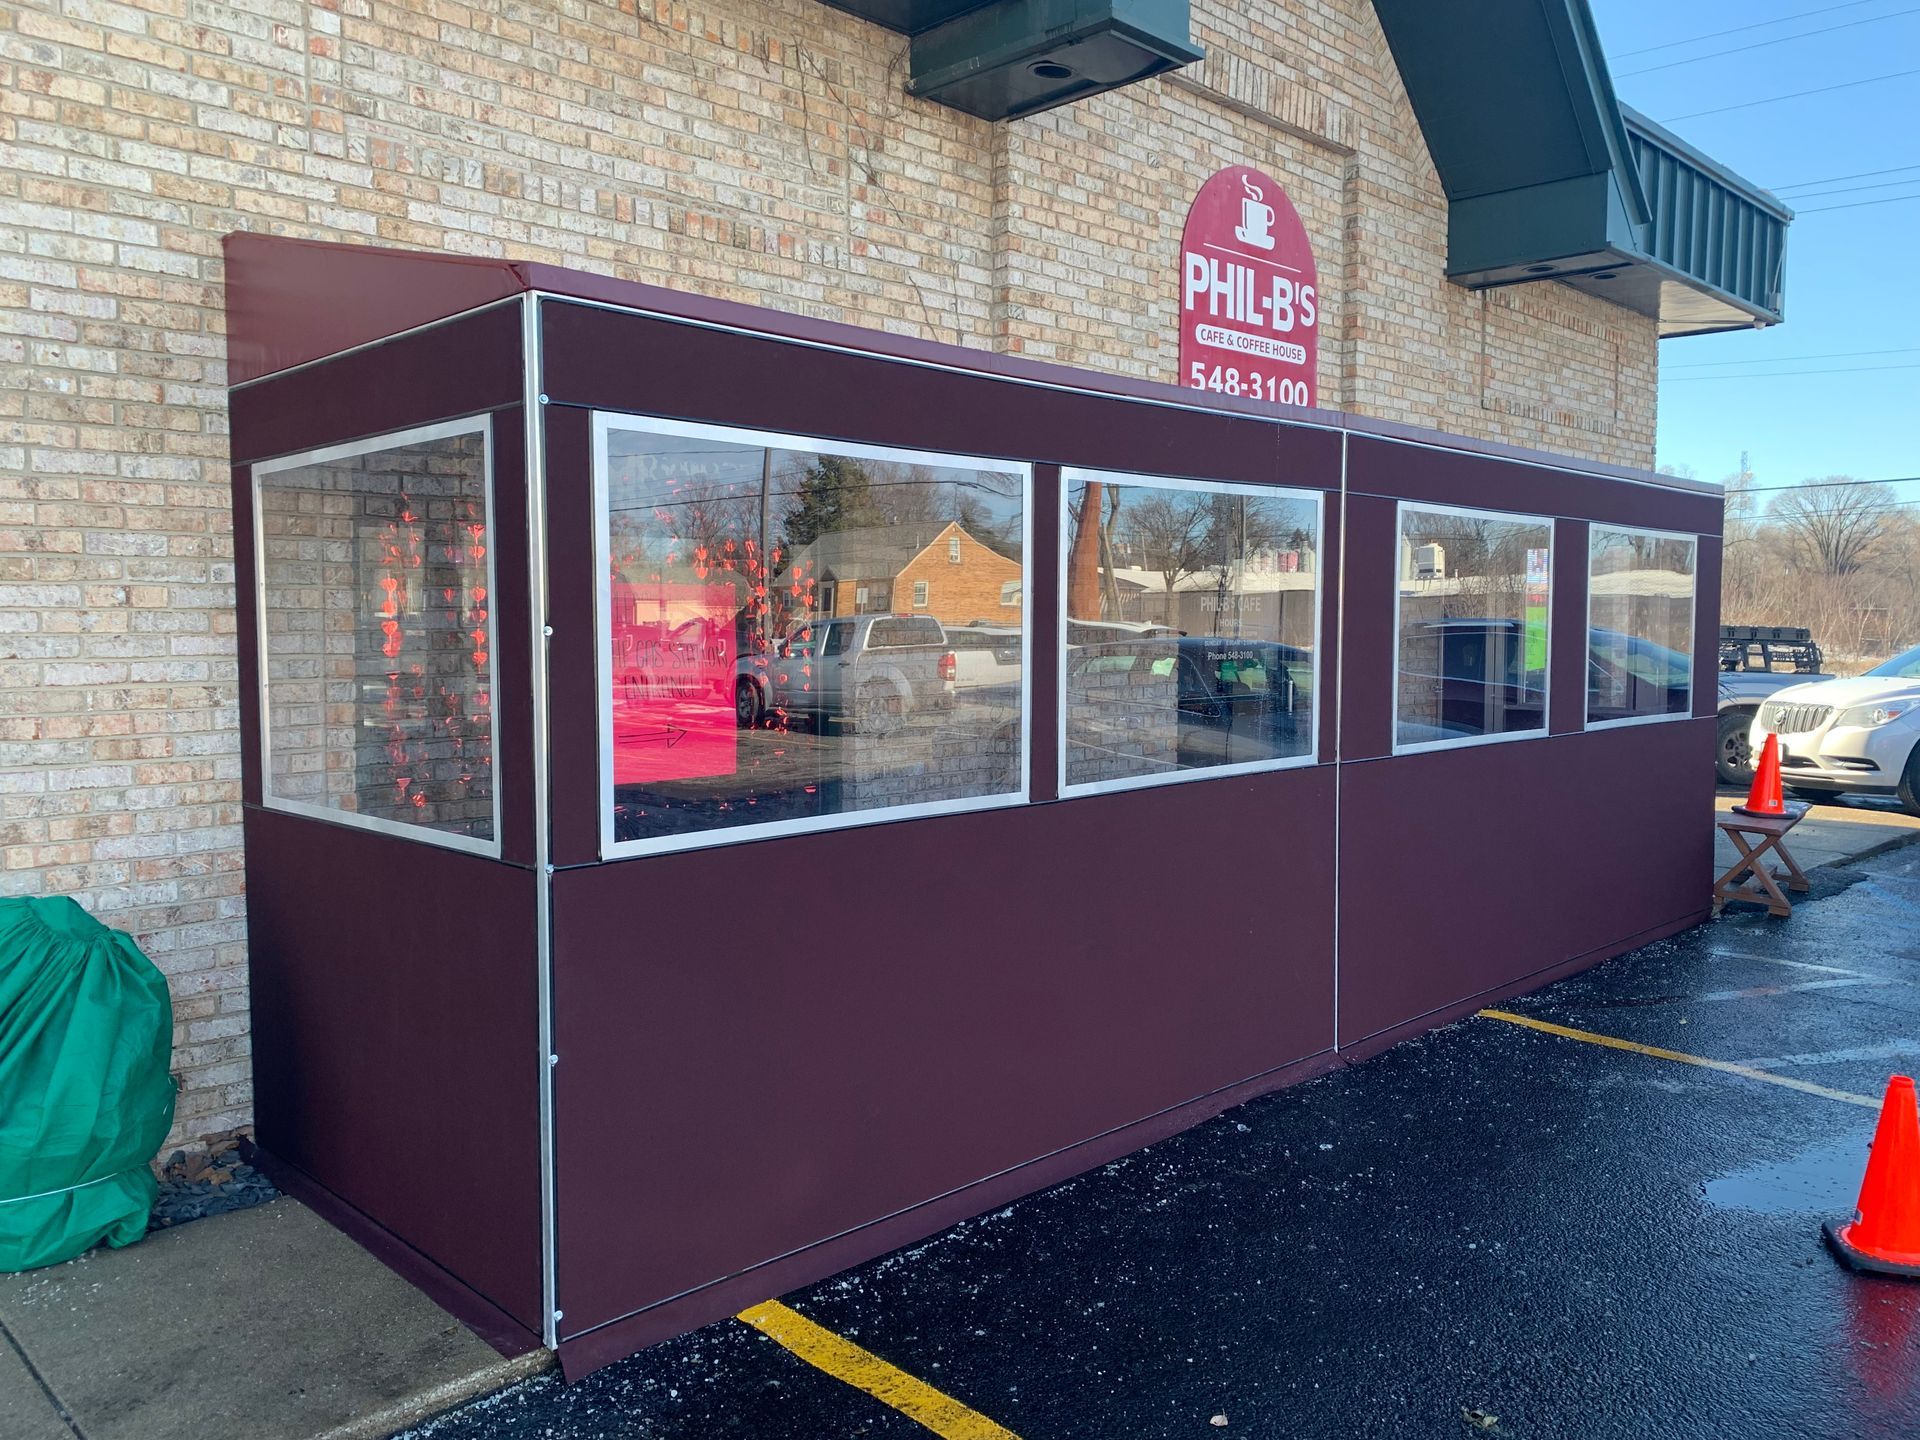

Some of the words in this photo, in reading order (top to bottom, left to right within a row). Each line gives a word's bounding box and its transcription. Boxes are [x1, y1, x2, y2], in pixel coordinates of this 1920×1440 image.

[1185, 251, 1316, 332] PHIL-B'S
[1200, 328, 1225, 345] CAFE
[1226, 334, 1234, 346] &
[1236, 335, 1271, 354] COFFEE
[1272, 344, 1302, 361] HOUSE
[1190, 361, 1308, 407] 548-3100
[1207, 651, 1227, 661] Phone
[1227, 650, 1254, 660] 548-3100
